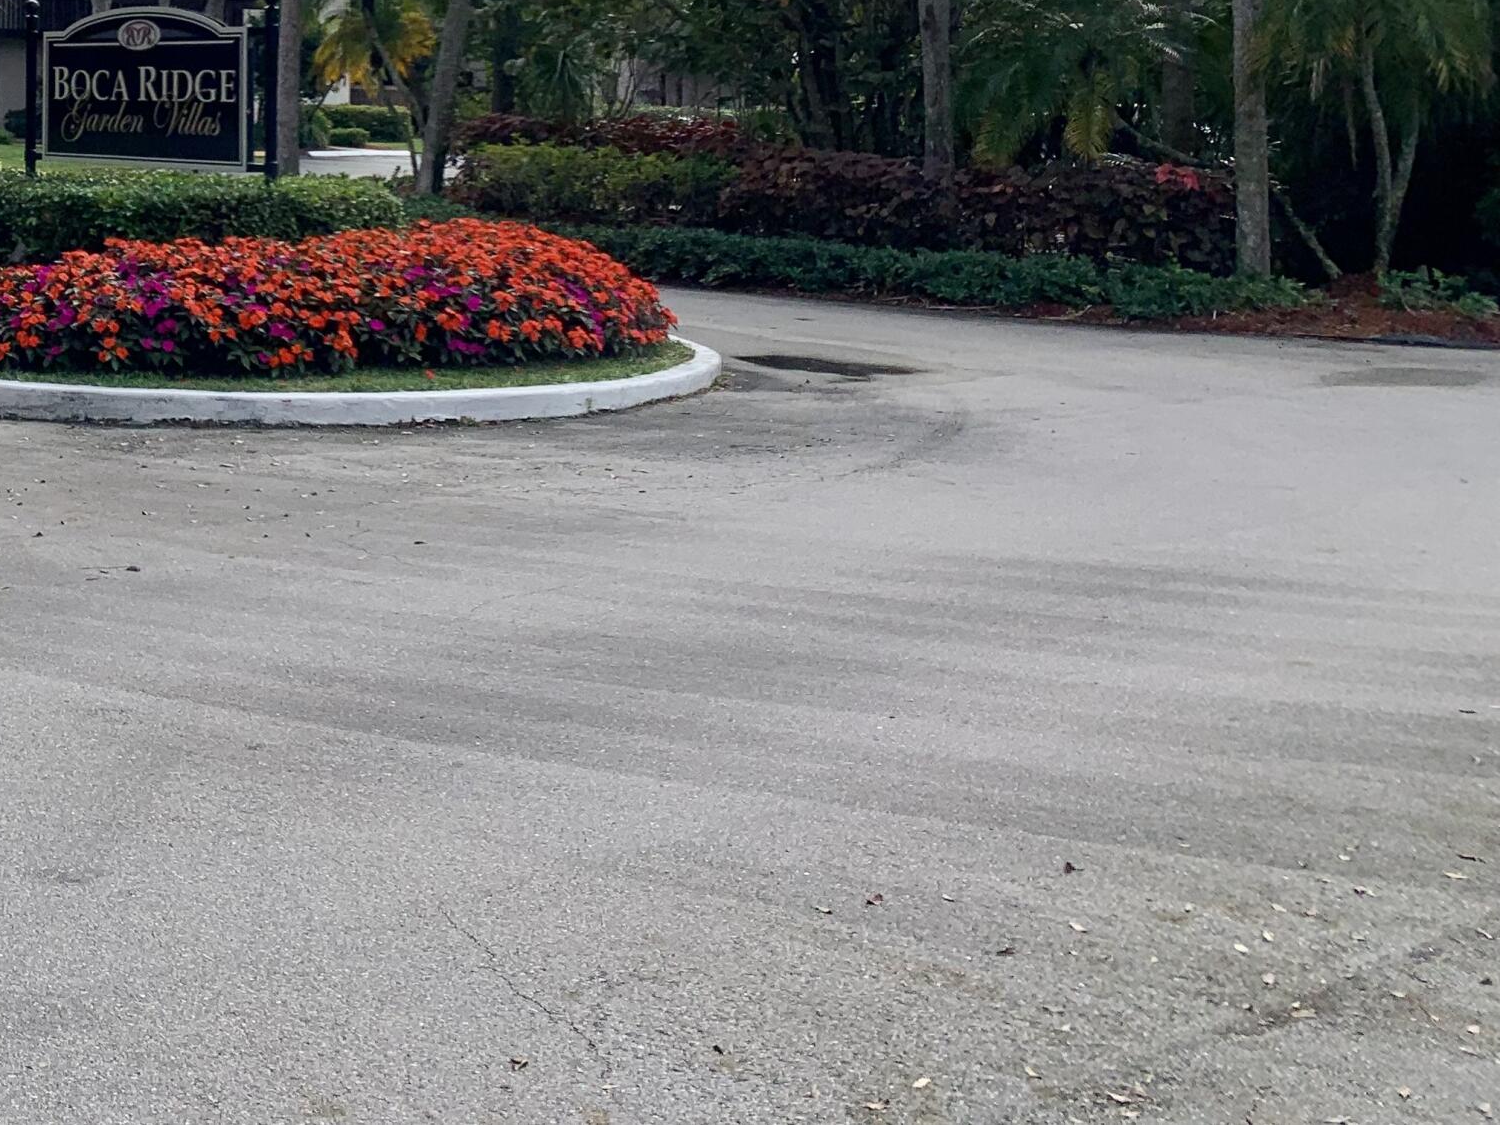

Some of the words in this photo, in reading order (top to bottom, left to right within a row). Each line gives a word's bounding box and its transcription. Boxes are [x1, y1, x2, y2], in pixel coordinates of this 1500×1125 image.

[52, 66, 130, 101] BOCA
[137, 66, 236, 103] RIDGE
[61, 87, 144, 142] Garden
[153, 93, 221, 137] Villas
